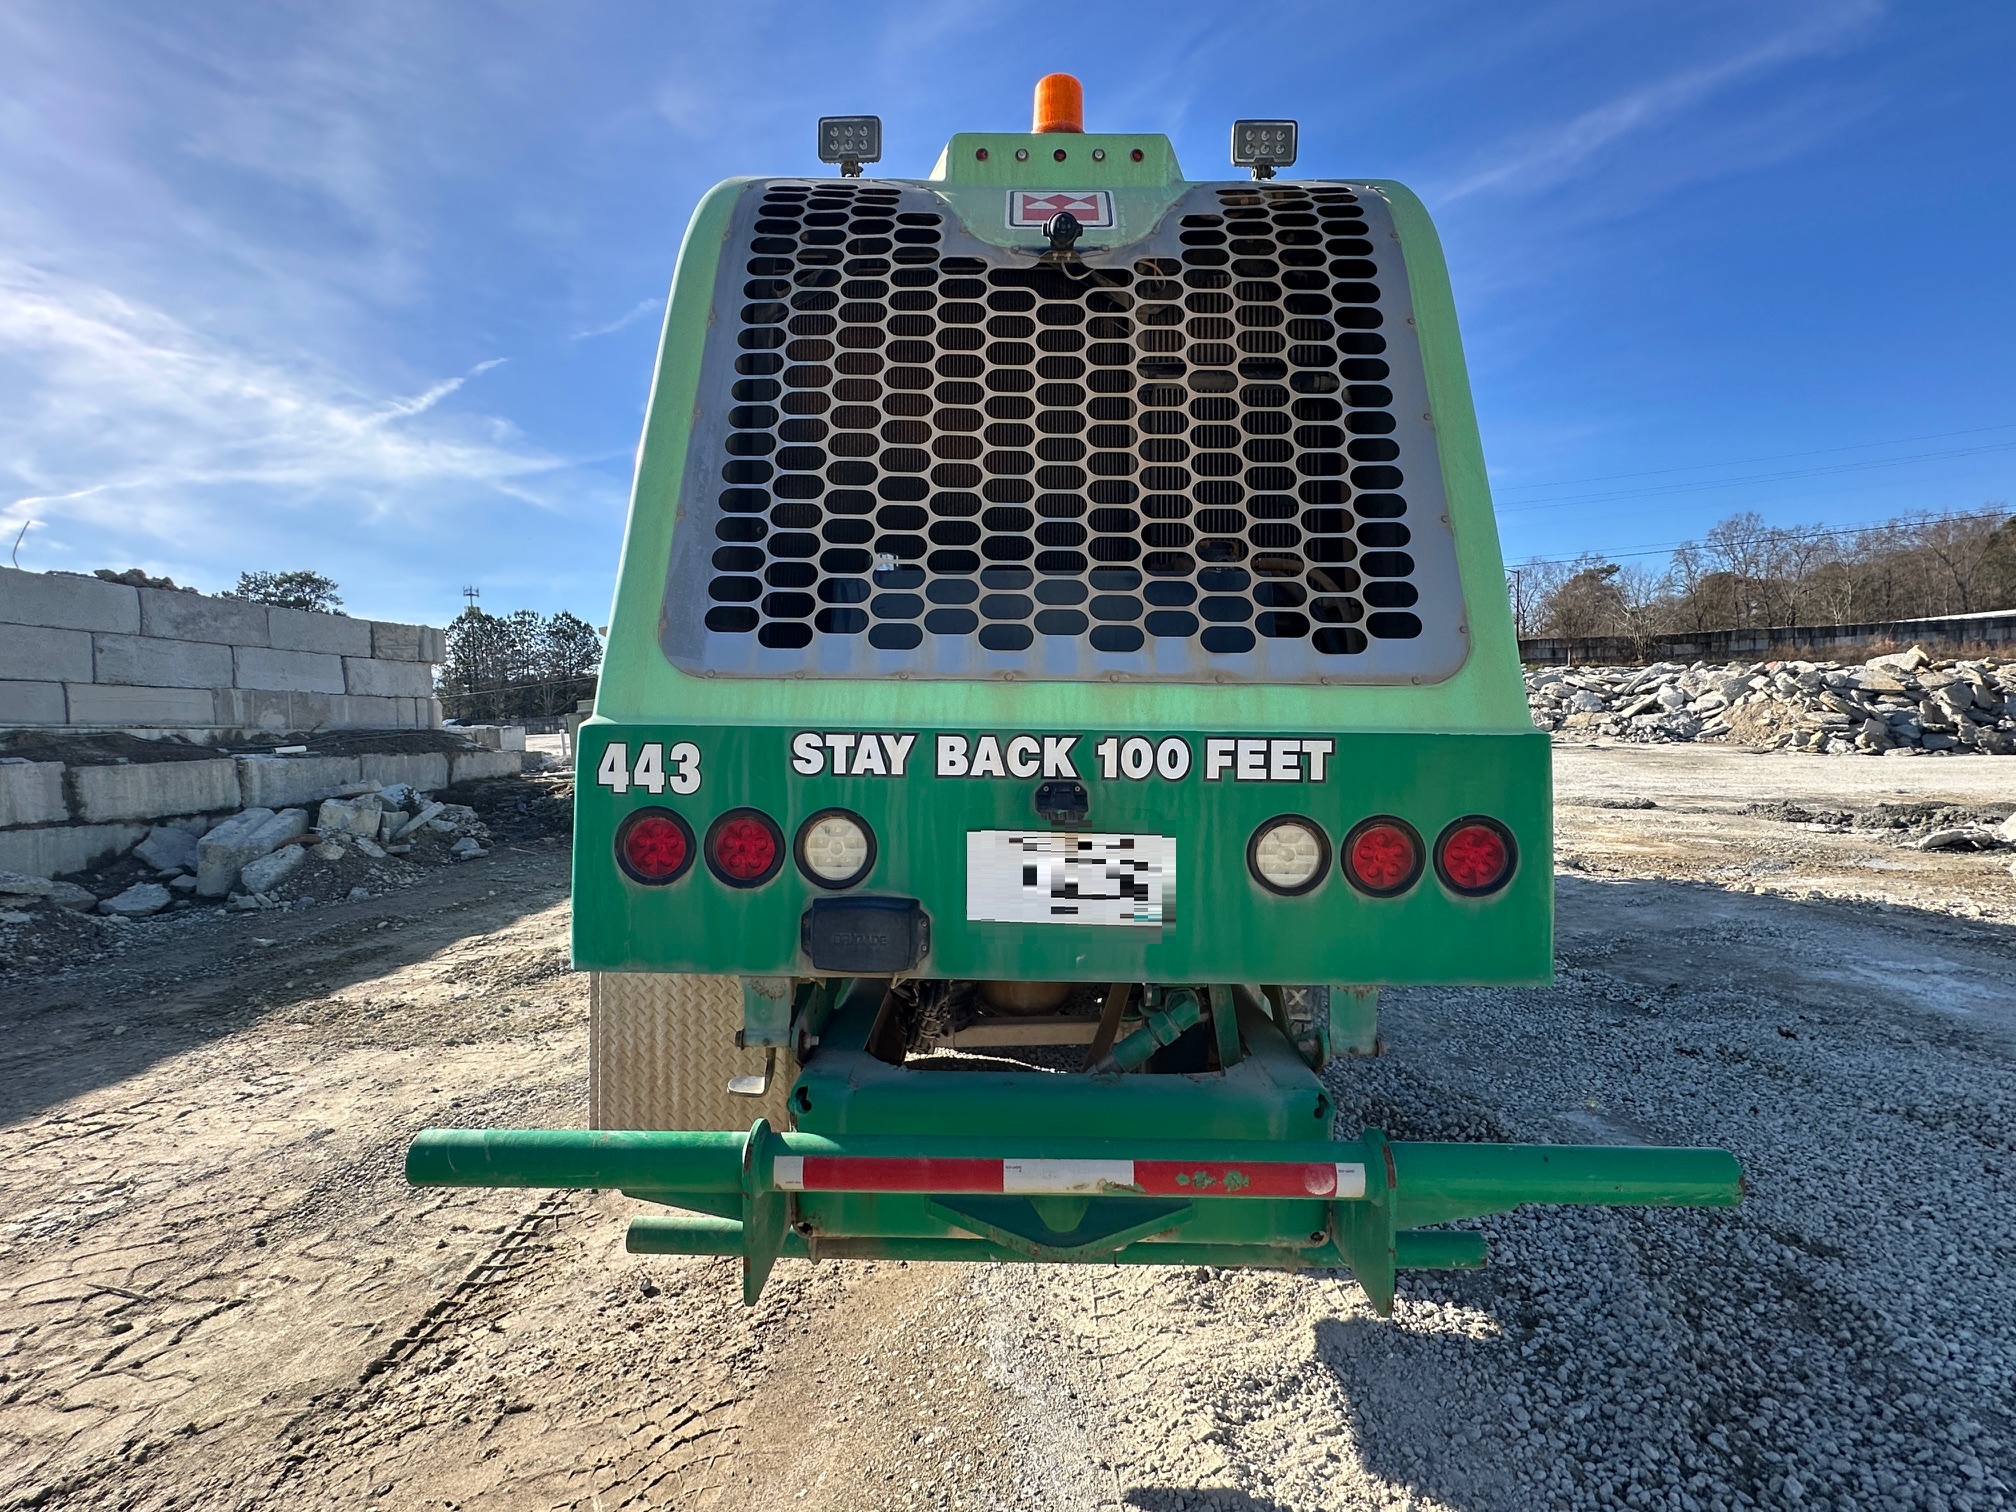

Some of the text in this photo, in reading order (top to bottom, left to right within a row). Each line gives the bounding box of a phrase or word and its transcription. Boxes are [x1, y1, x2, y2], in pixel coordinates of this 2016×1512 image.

[596, 740, 702, 796] 443
[791, 732, 1336, 783] STAY BACK 100 FEET
